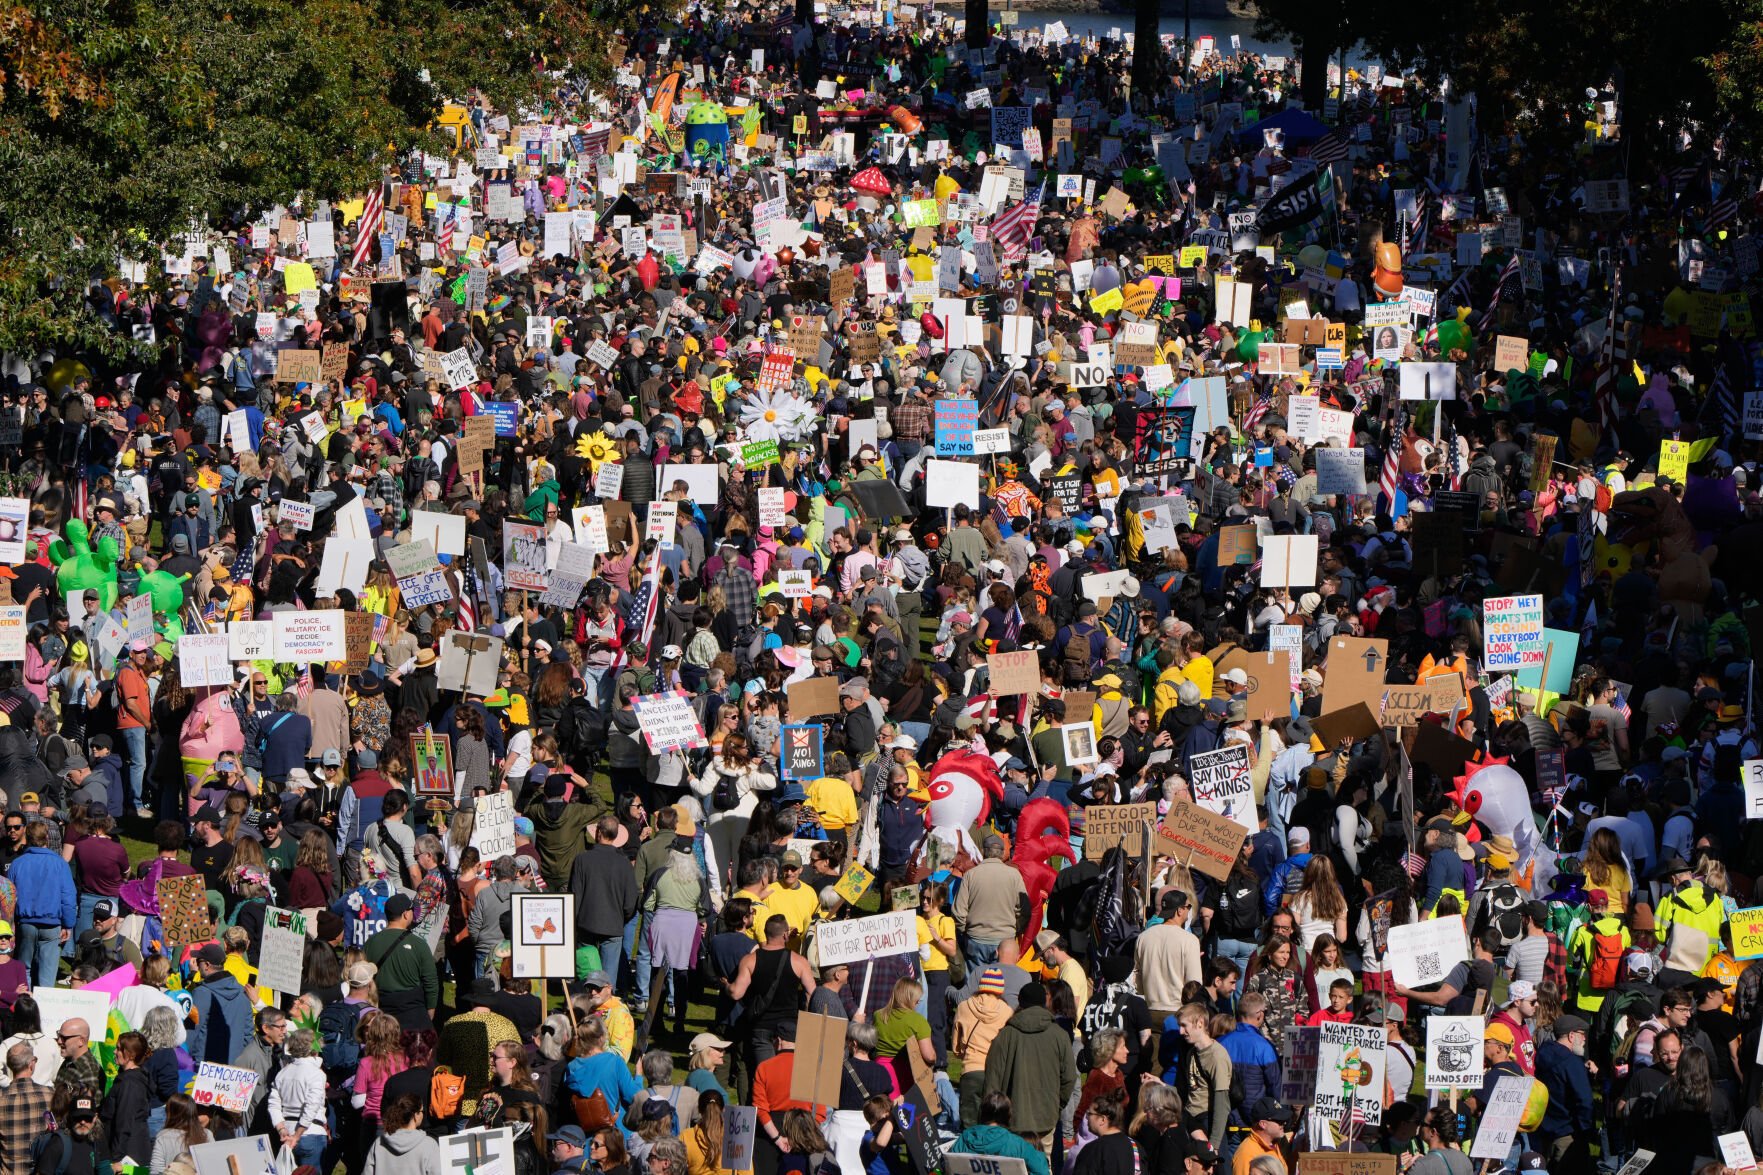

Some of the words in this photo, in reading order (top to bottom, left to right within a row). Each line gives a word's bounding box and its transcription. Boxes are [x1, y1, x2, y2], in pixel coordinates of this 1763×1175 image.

[692, 181, 710, 191] DUTY
[1232, 224, 1257, 234] KINGS
[1192, 233, 1215, 247] FUCK
[1215, 234, 1227, 249] ICE
[1146, 258, 1172, 268] FUCK
[1000, 280, 1015, 289] NO
[1414, 290, 1434, 303] LOVE
[1366, 310, 1409, 318] BLACKMAILING
[861, 322, 876, 331] USA
[1128, 325, 1145, 335] NO
[1327, 328, 1343, 341] We
[282, 352, 315, 362] Listen
[448, 348, 468, 366] KINGS
[280, 365, 319, 379] LEARN
[453, 368, 471, 386] 1776
[1075, 367, 1105, 385] NO
[939, 401, 959, 409] THIS
[961, 401, 976, 410] ALL
[935, 412, 956, 420] ENDS
[957, 412, 978, 420] WHEN
[939, 422, 975, 430] ENOUGH
[959, 433, 972, 441] US
[974, 432, 1006, 442] RESIST
[745, 445, 755, 454] NO
[755, 440, 776, 452] KINGS
[940, 443, 957, 452] SAY
[958, 443, 974, 451] NO
[745, 456, 755, 464] NO
[1135, 458, 1188, 473] RESIST
[1064, 480, 1081, 488] FIGHT
[1194, 475, 1206, 490] NO
[1066, 488, 1078, 496] THE
[283, 502, 311, 514] TRUCK
[286, 510, 304, 519] FUMP
[394, 556, 439, 575] IMMIGRANTS
[398, 578, 420, 592] ICE
[424, 571, 442, 584] OFF
[507, 570, 543, 586] RESIST!
[413, 584, 431, 594] OUR
[132, 594, 150, 612] LOVE
[405, 588, 451, 610] STREETS
[1517, 597, 1538, 608] HEY
[294, 617, 322, 625] POLICE,
[1523, 612, 1542, 621] THAT
[319, 625, 331, 633] ICE
[346, 626, 361, 635] LOVE
[1272, 626, 1284, 636] YOU
[1489, 631, 1540, 643] EVERYBODY
[245, 647, 260, 656] OFF
[284, 641, 325, 649] DEMOCRACY
[347, 645, 359, 653] NO
[1486, 642, 1513, 654] LOOK
[295, 648, 324, 656] FASCISM
[1488, 652, 1521, 664] GOING
[1522, 650, 1544, 663] DOWN
[994, 653, 1029, 668] STOP
[1505, 677, 1513, 686] IS
[642, 702, 687, 717] ANCESTORS
[645, 716, 671, 727] DIDN'T
[673, 714, 689, 723] WANT
[657, 726, 681, 738] KING
[681, 724, 694, 733] AND
[652, 738, 678, 750] NEITHER
[793, 748, 812, 759] NO!
[1195, 757, 1207, 769] We
[1220, 750, 1244, 764] People
[791, 758, 816, 770] KINGS
[1193, 769, 1214, 786] SAY
[1214, 765, 1231, 782] NO
[1214, 775, 1251, 799] KINGS
[489, 793, 506, 812] ICE
[1119, 806, 1154, 820] GOP:
[1088, 821, 1134, 835] DEFEND
[1174, 801, 1211, 828] PRISON
[1214, 824, 1242, 842] W/OUT
[1178, 819, 1197, 834] DUE
[1202, 829, 1238, 851] PROCESS
[159, 879, 178, 891] NO
[168, 876, 198, 942] DICTATOR
[265, 907, 279, 928] NO
[189, 927, 210, 942] NO
[820, 926, 837, 940] MEN
[842, 923, 853, 935] OF
[858, 917, 891, 934] QUALITY
[894, 916, 904, 927] DO
[825, 939, 842, 958] NOT
[864, 928, 908, 953] EQUALITY
[1324, 1023, 1366, 1040] WANTED
[1367, 1029, 1381, 1041] TO
[1444, 1034, 1469, 1042] RESIST
[1320, 1033, 1385, 1051] HURKLE-DURKLE
[200, 1063, 260, 1084] DEMOCRACY
[1428, 1074, 1461, 1084] HANDS
[1462, 1074, 1482, 1084] OFF!
[214, 1082, 231, 1092] HAS
[193, 1089, 214, 1104] NO
[215, 1093, 248, 1111] Kings!!
[1316, 1093, 1335, 1106] BUT
[1366, 1099, 1380, 1112] TO
[1495, 1090, 1523, 1104] RADICAL
[1315, 1106, 1340, 1119] FIGHT
[729, 1110, 741, 1135] 86
[741, 1122, 750, 1133] the
[1493, 1131, 1508, 1144] ALL
[932, 1139, 943, 1160] THE
[969, 1159, 1000, 1175] DUE
[1302, 1159, 1348, 1173] RESIST
[1350, 1161, 1367, 1169] LIKE
